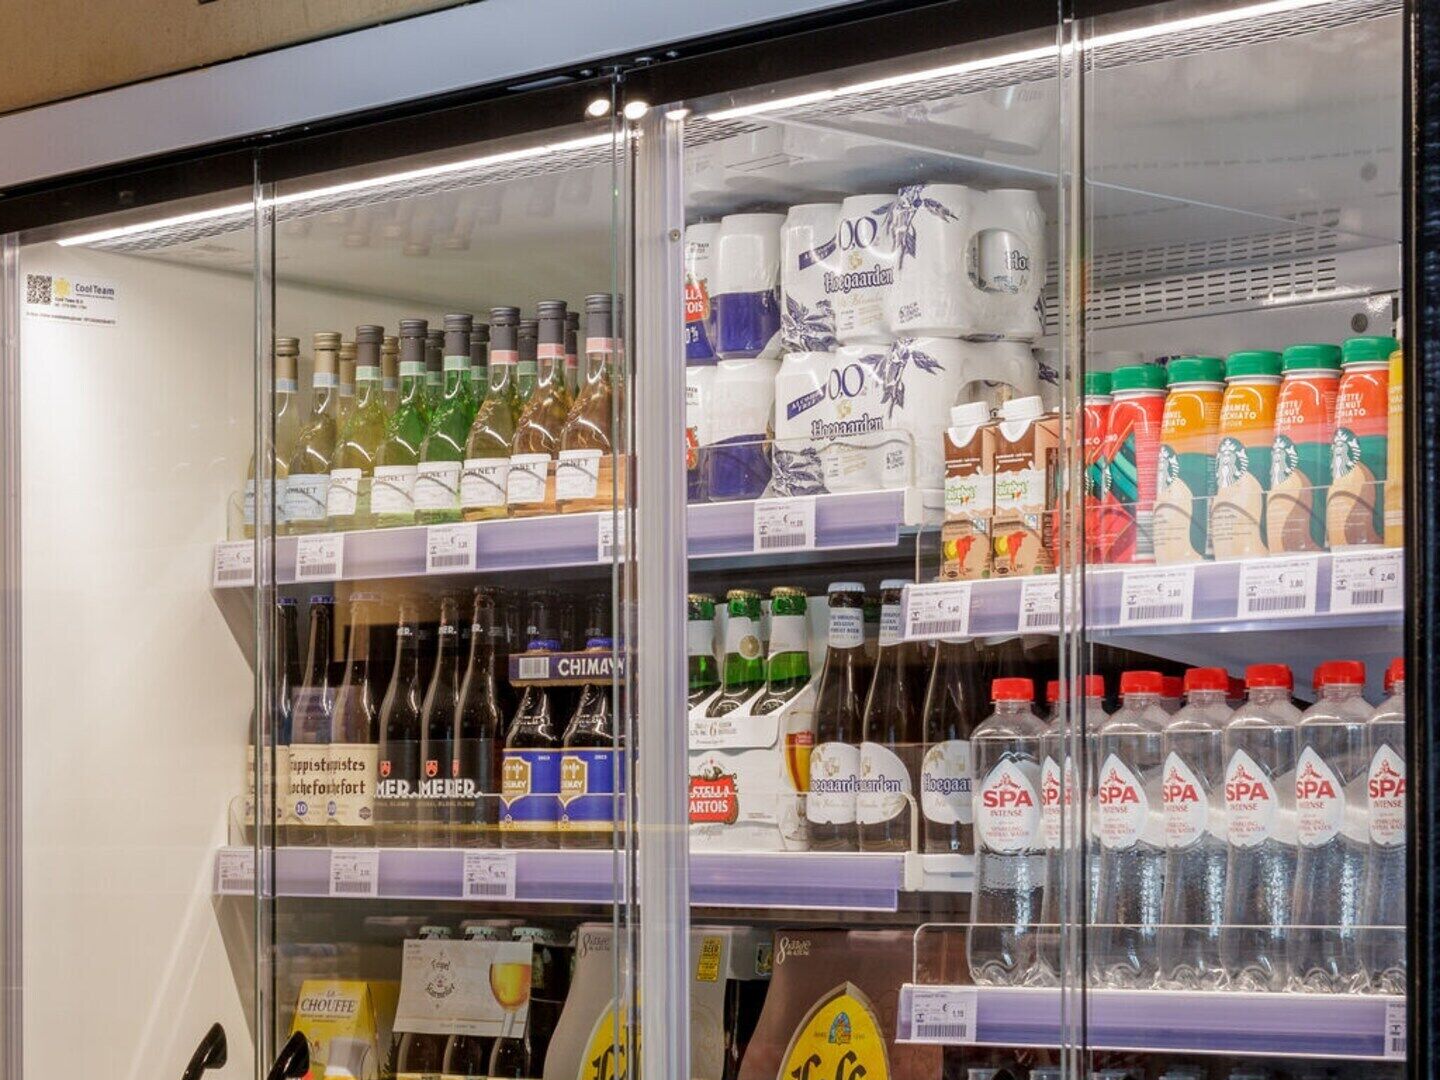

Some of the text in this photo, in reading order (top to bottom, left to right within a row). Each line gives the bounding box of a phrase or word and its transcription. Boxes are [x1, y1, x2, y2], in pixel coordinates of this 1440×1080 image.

[824, 264, 894, 294] Hoegaarden
[75, 283, 115, 296] Cool Team
[811, 413, 884, 441] Hoegaarden
[690, 785, 729, 799] STELLA
[983, 789, 1034, 808] SPA
[1099, 786, 1140, 805] SPA
[1162, 784, 1199, 802] SPA
[1225, 783, 1269, 801] SPA
[1296, 780, 1336, 799] SPA
[689, 800, 728, 814] ARTOIS
[300, 997, 356, 1013] CHOUFFE
